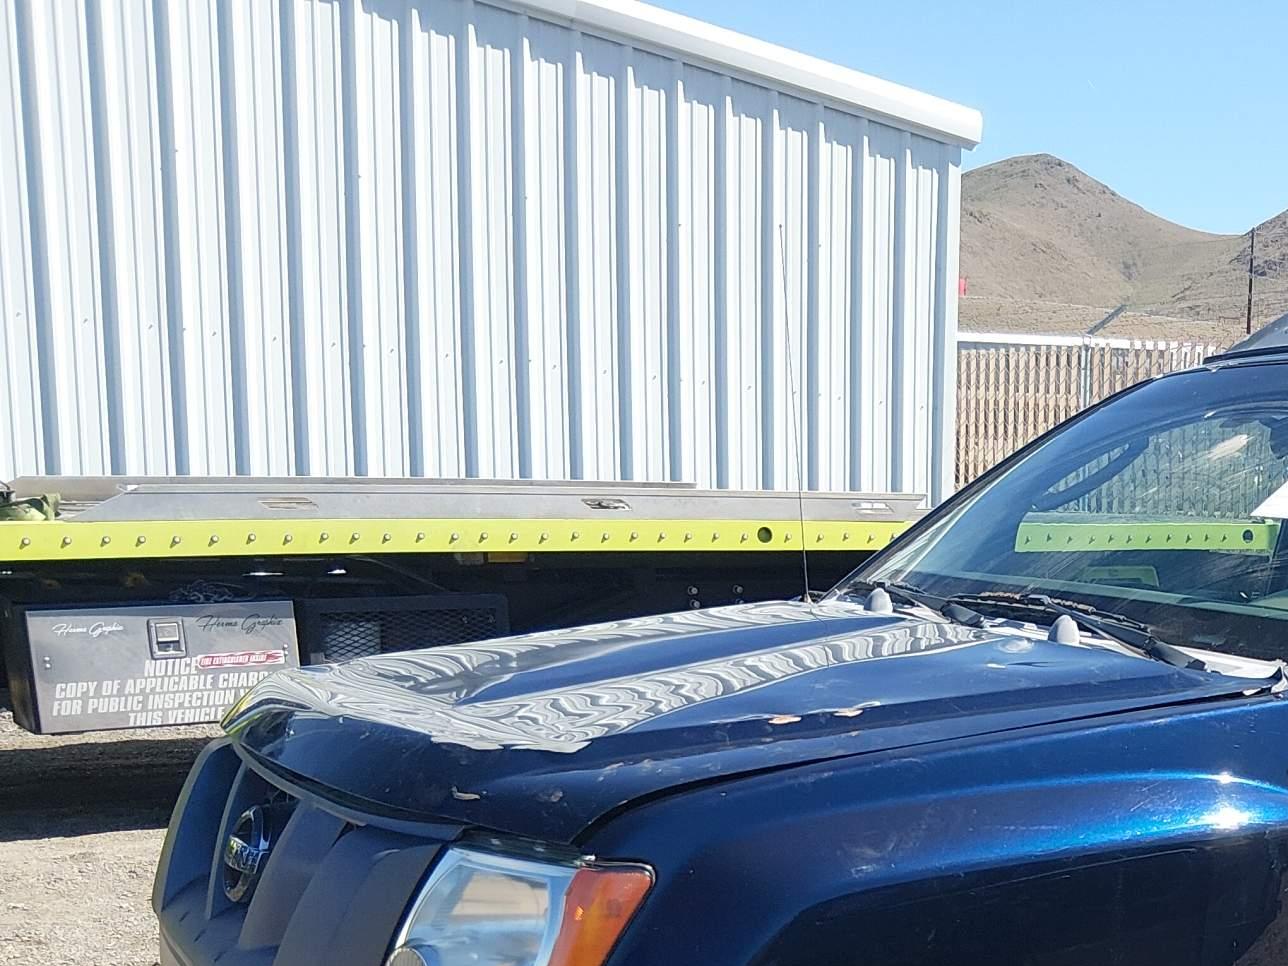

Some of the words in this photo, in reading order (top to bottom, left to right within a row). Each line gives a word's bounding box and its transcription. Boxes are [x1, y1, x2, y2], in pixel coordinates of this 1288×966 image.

[144, 657, 198, 677] NOTICE
[55, 681, 97, 699] COPY
[102, 680, 121, 696] OF
[125, 674, 214, 695] APPLICABLE
[52, 700, 82, 716] FOR
[87, 695, 143, 714] PUBLIC
[147, 688, 235, 710] INSPECTION
[128, 711, 163, 727] THIS
